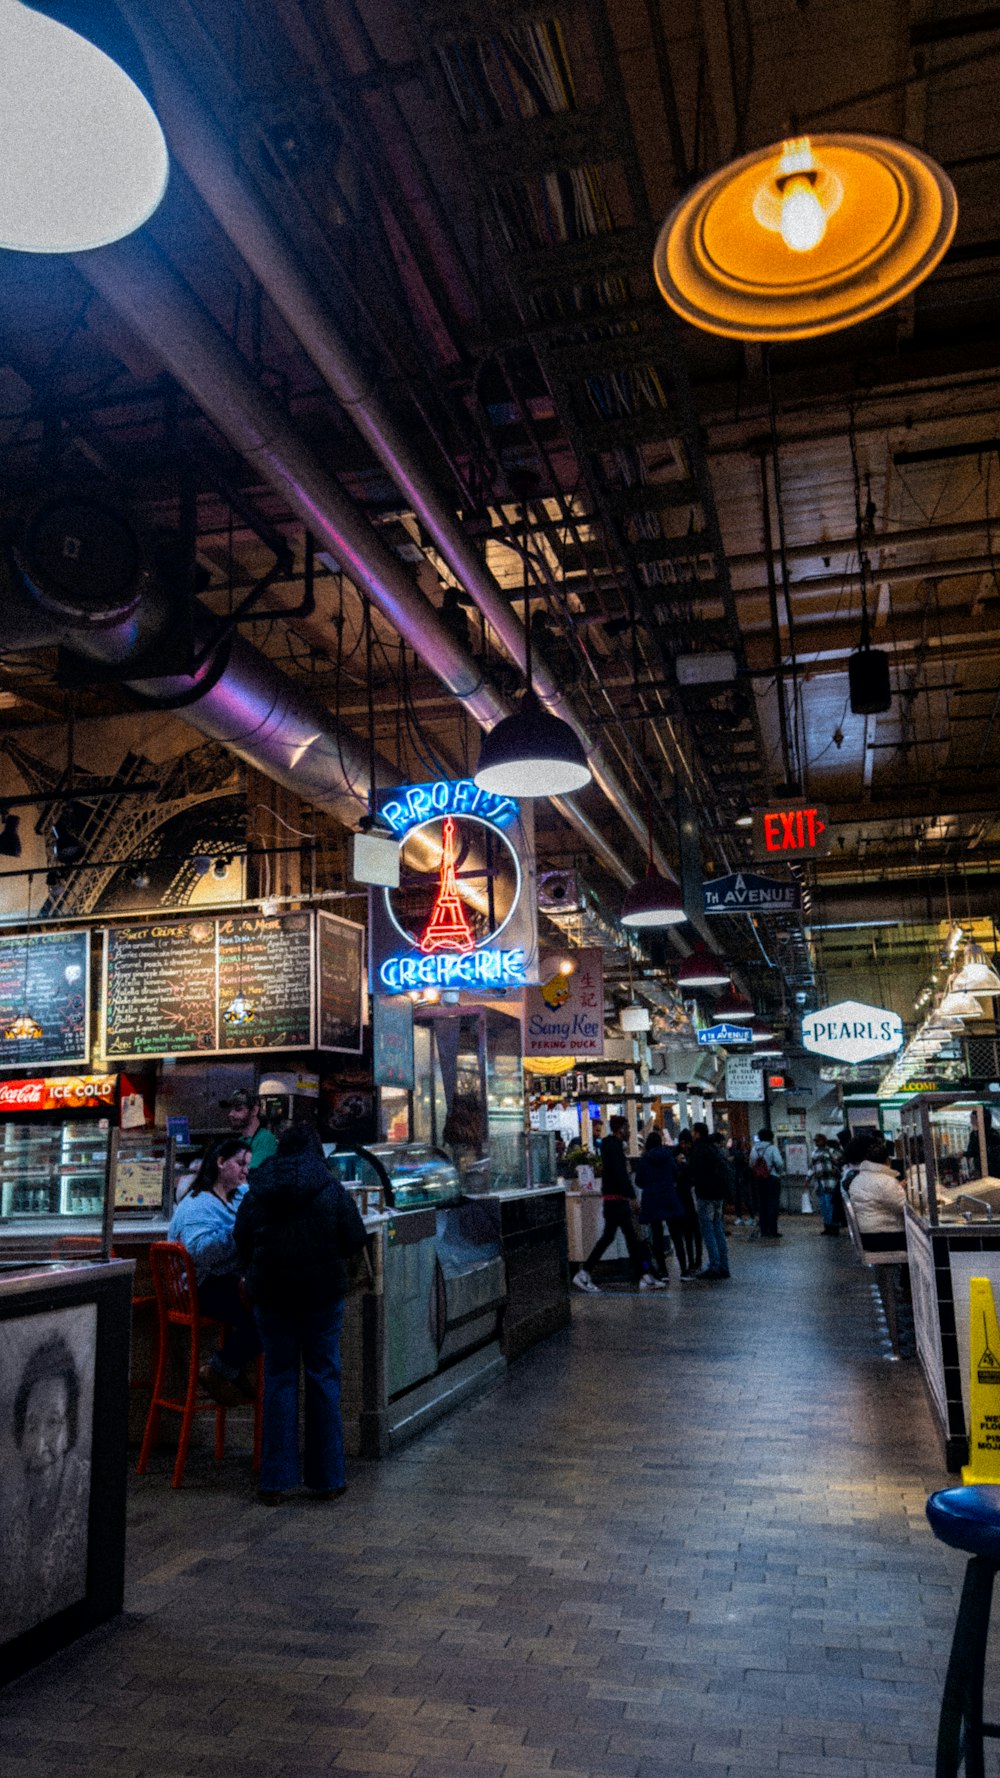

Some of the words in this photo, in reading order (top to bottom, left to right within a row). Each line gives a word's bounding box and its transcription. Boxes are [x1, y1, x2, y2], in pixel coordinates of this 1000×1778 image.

[764, 809, 817, 851] EXIT
[724, 888, 796, 903] AVENUE
[380, 948, 524, 987] CREPERIE
[528, 1014, 570, 1040] Sang
[572, 1013, 599, 1038] Kee
[716, 1031, 750, 1040] AVENUE
[531, 1040, 566, 1049] PEKING
[570, 1039, 597, 1048] DUCK
[49, 1086, 72, 1098] ICE
[75, 1083, 112, 1097] COLD
[984, 1415, 1000, 1423] WE
